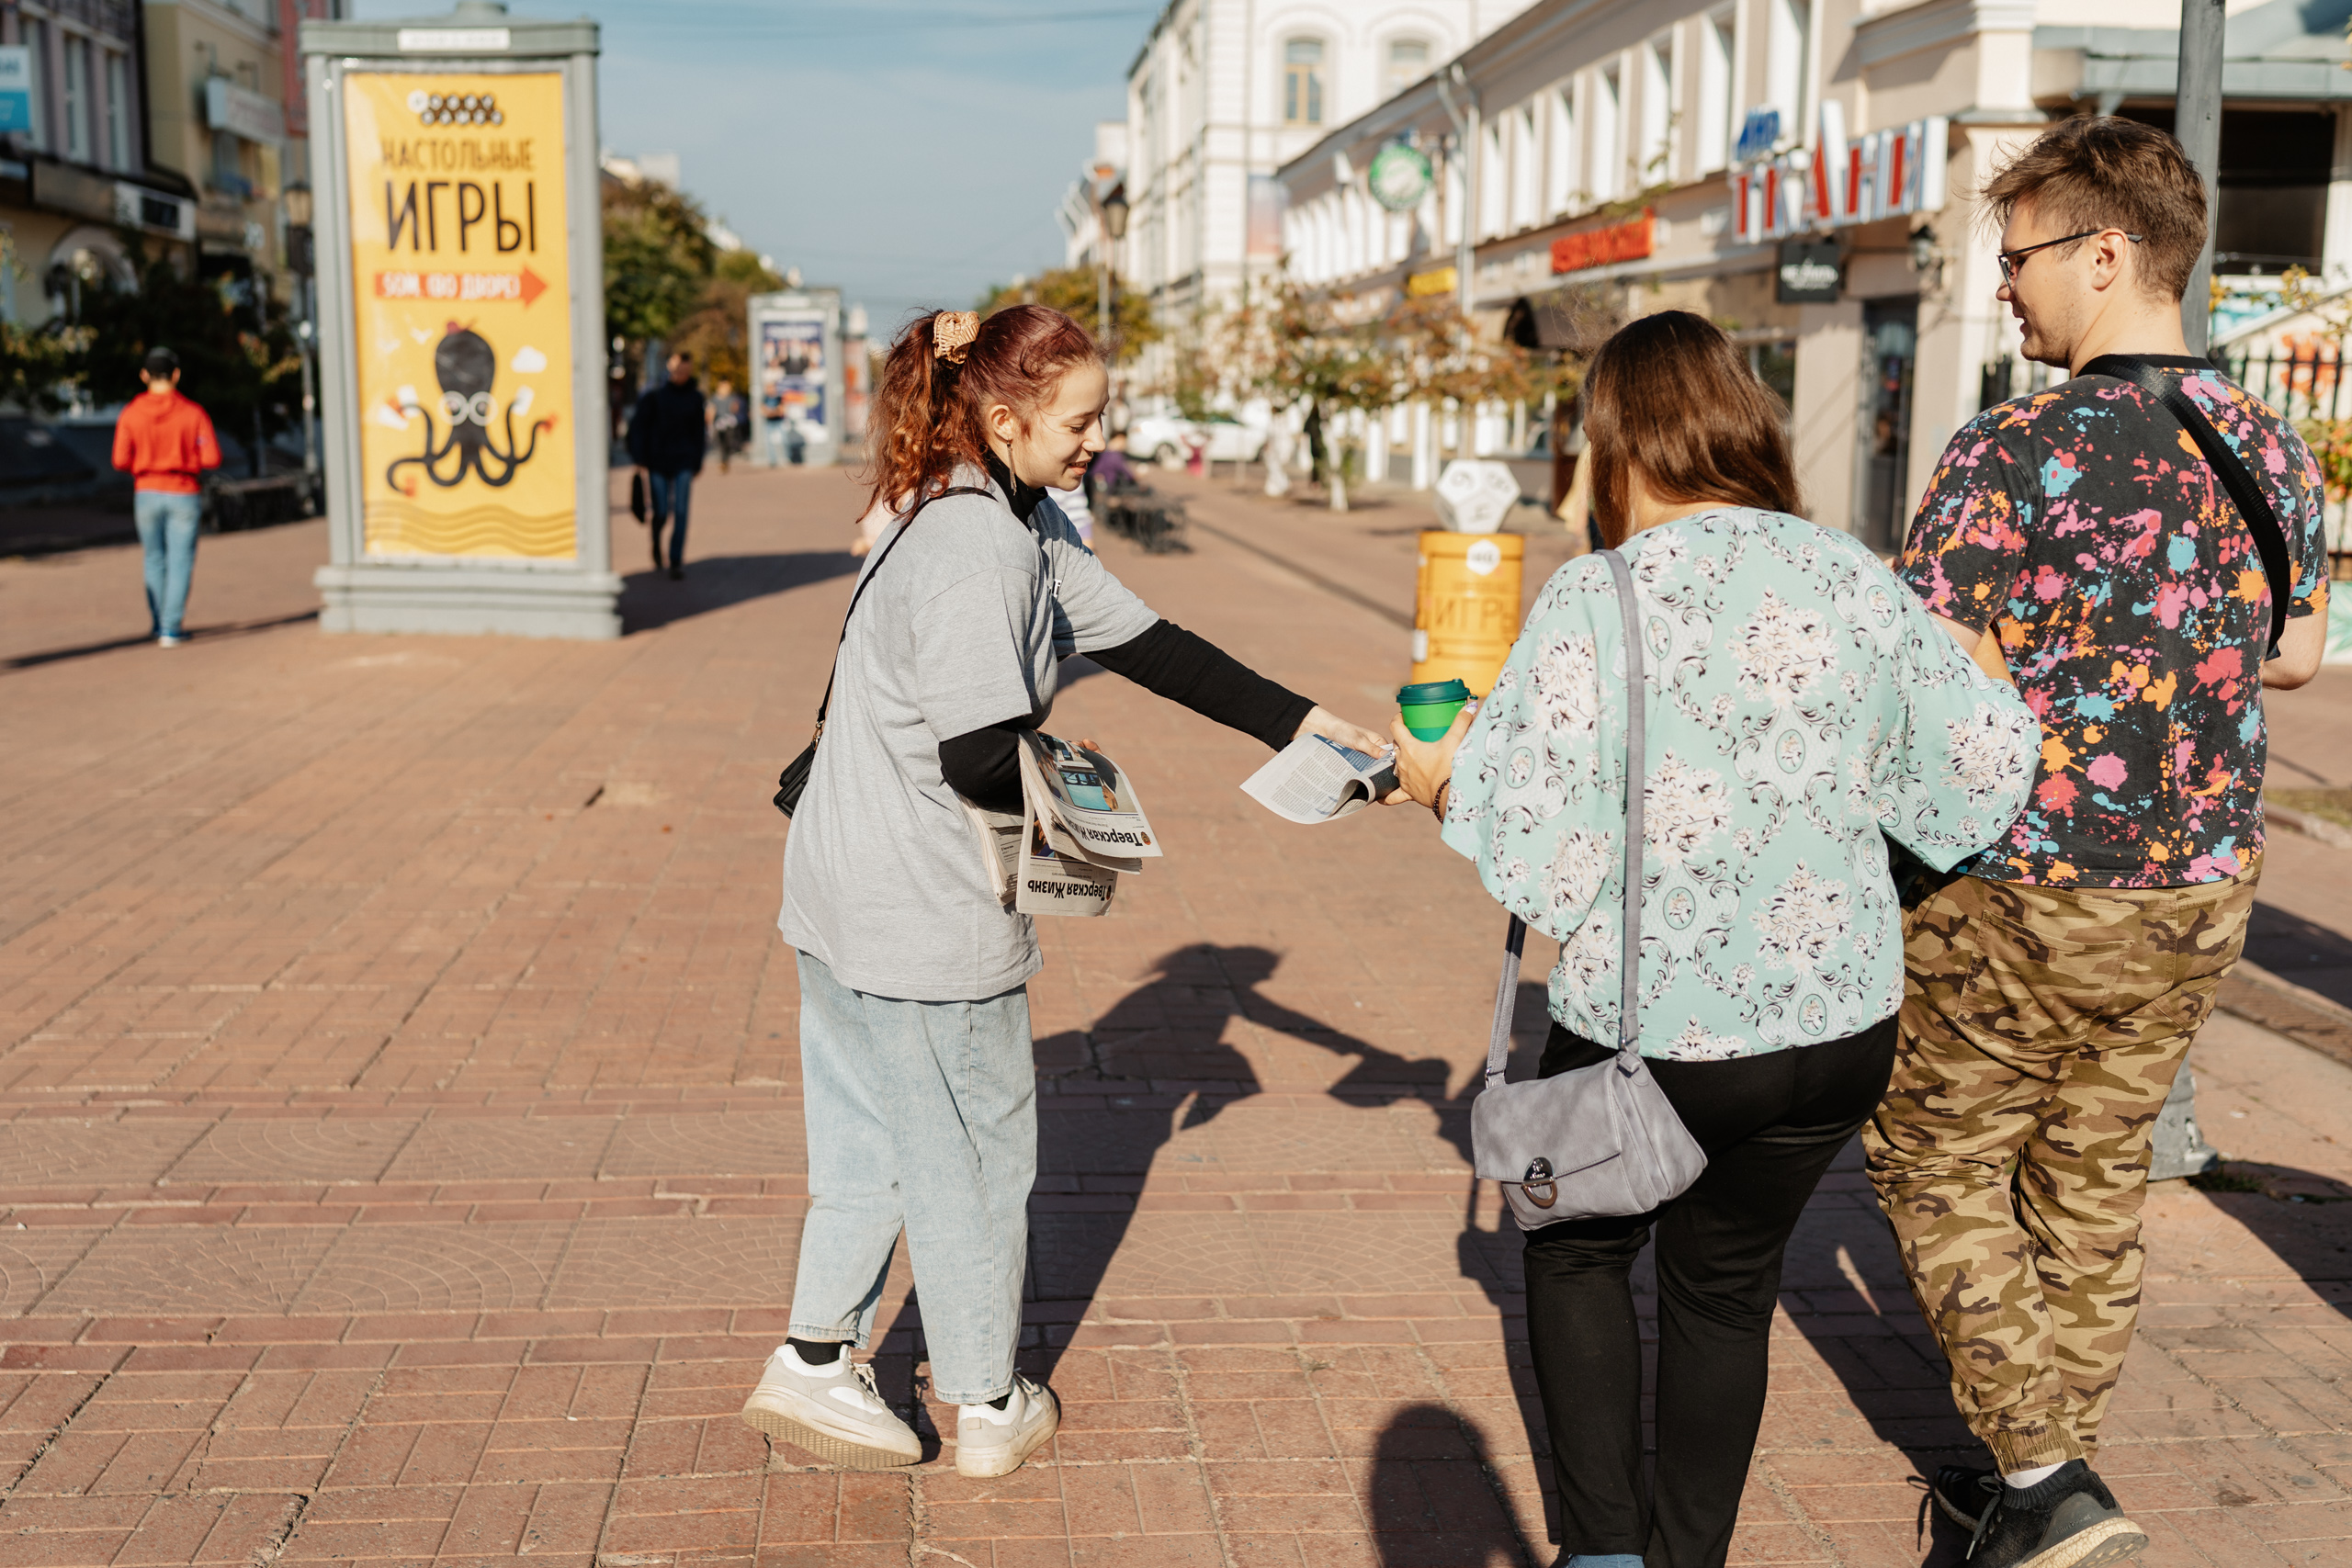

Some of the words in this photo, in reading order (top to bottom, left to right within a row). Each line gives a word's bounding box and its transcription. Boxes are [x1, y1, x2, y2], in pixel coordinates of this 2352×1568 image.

[381, 139, 535, 171] НАСТОЛЬНЫЕ
[386, 181, 537, 252] ИГРЫ
[1088, 828, 1143, 846] Тверская
[1027, 880, 1066, 898] Жизнь
[1067, 881, 1105, 901] Тверская
